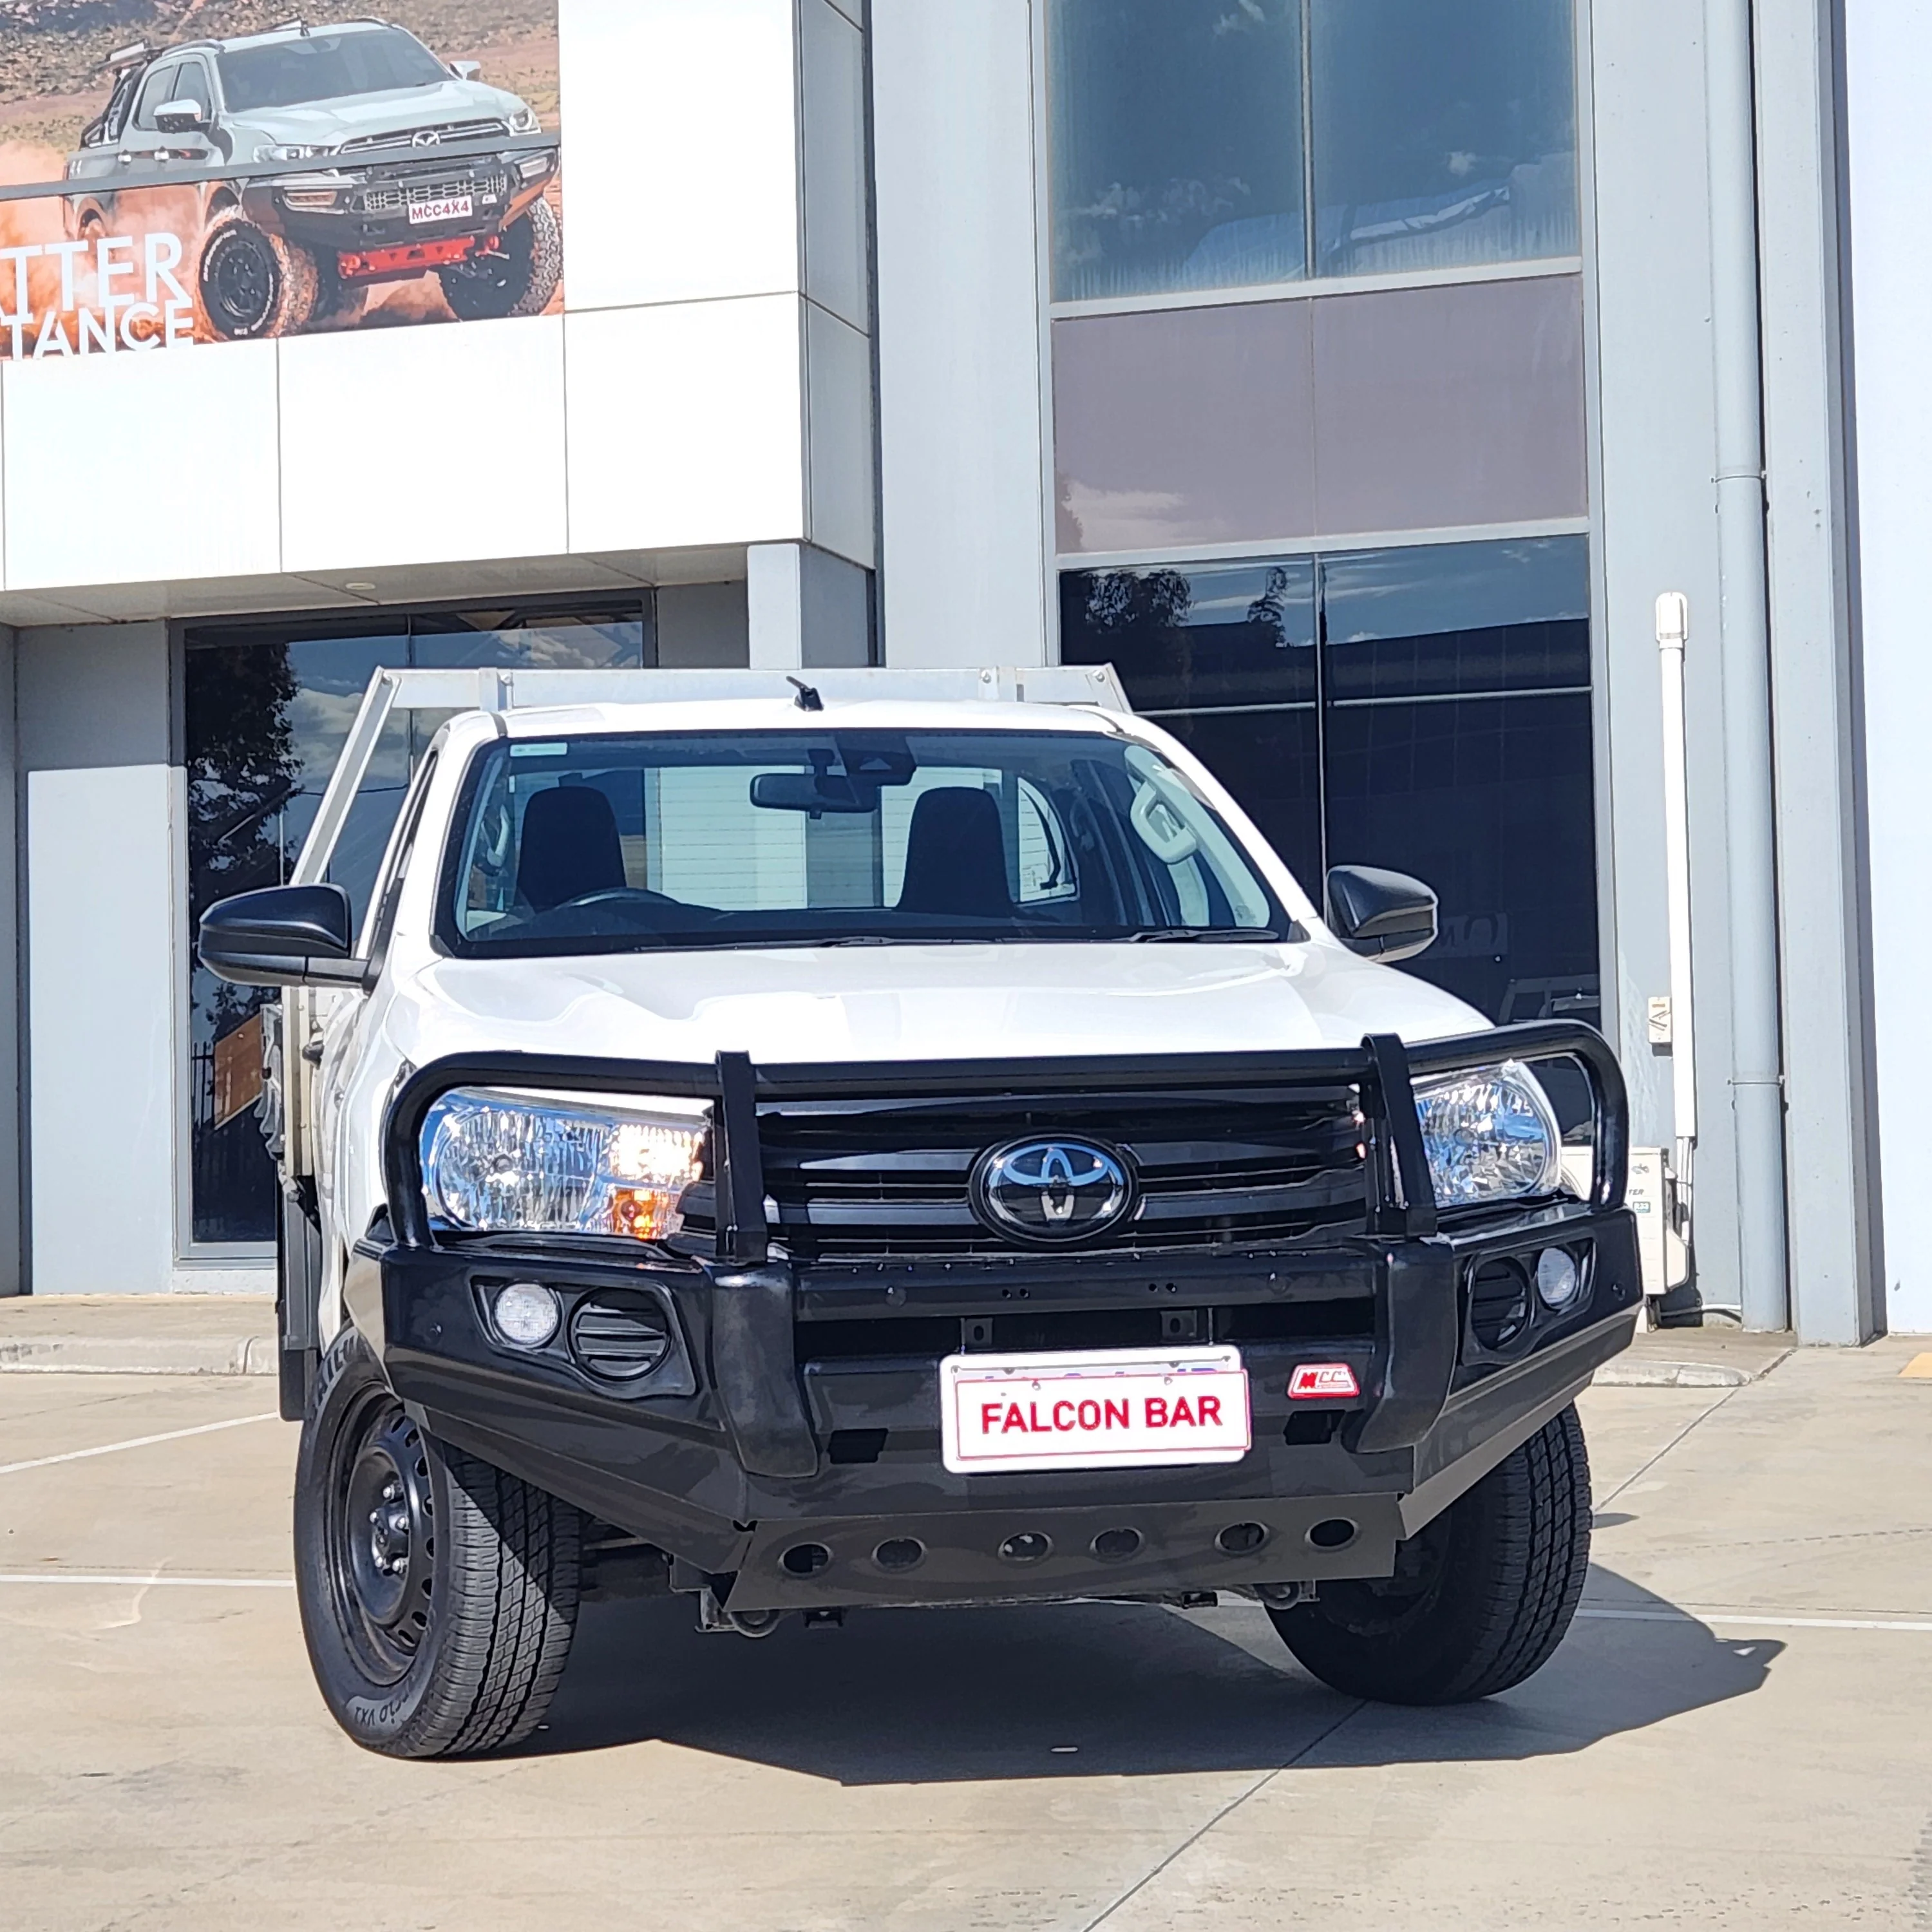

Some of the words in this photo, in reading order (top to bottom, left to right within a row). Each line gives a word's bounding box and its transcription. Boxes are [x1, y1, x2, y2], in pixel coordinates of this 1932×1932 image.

[412, 200, 469, 220] MCC4X4
[0, 232, 193, 316] TTER
[981, 1398, 1130, 1434] FALCON
[1144, 1395, 1224, 1428] BAR
